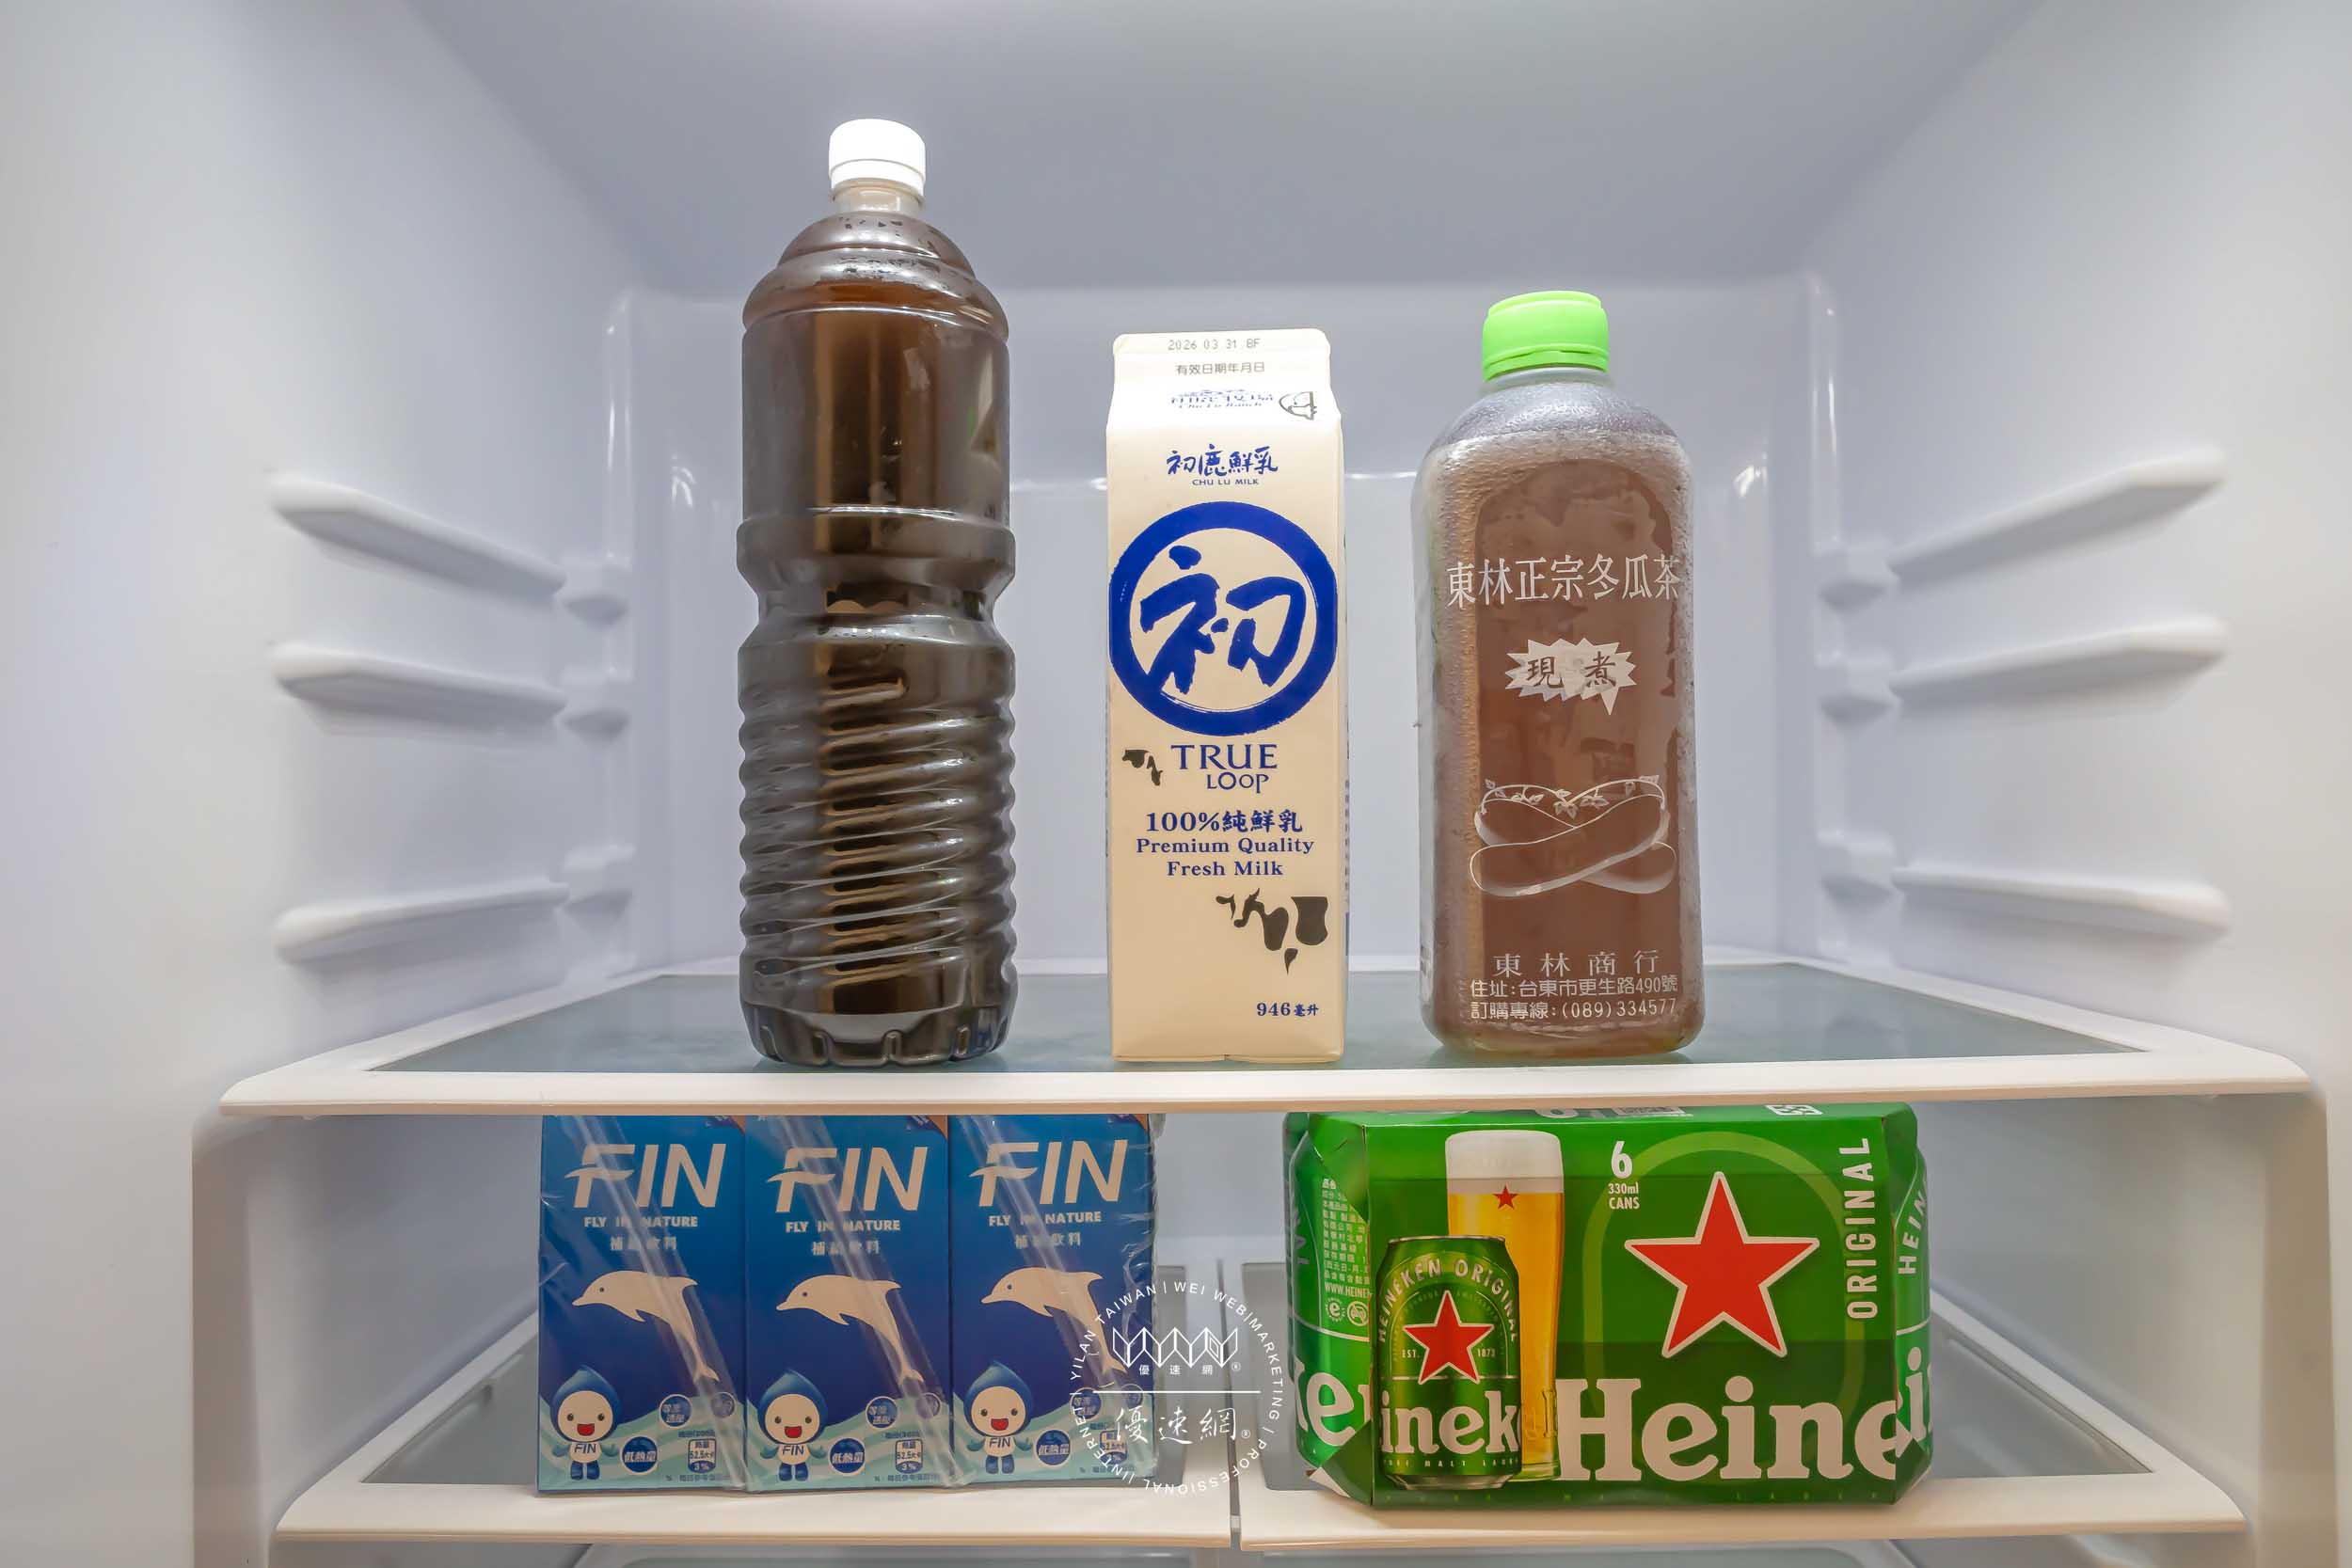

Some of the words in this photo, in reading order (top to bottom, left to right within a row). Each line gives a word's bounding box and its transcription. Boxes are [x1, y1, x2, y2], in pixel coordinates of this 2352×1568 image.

[1168, 340, 1197, 351] 2026
[1203, 339, 1218, 350] 03
[1226, 339, 1237, 349] 31
[1174, 361, 1265, 375] 有效日期年月日
[1166, 443, 1279, 476] 初鹿鮮乳
[1445, 553, 1682, 609] 東林正宗冬瓜茶
[1140, 545, 1307, 695] 初
[1526, 651, 1616, 689] 現煮
[1170, 744, 1278, 770] TRUE
[1146, 809, 1303, 833] 100%純鮮乳
[1136, 838, 1229, 853] Premium
[1237, 837, 1314, 854] Quality
[1167, 861, 1225, 876] Fresh
[1234, 861, 1283, 876] Milk
[1492, 950, 1661, 977] 東林商行
[1256, 1003, 1319, 1017] 946毫升
[1610, 1140, 1634, 1179] 6
[564, 1143, 726, 1209] FIN
[767, 1147, 928, 1212] FIN
[969, 1139, 1128, 1207] FIN
[1608, 1182, 1639, 1195] 330ml
[1608, 1196, 1640, 1210] CANS
[583, 1216, 607, 1227] FLY
[642, 1215, 698, 1227] NATURE
[786, 1221, 809, 1233] FLY
[842, 1219, 900, 1232] NATURE
[989, 1214, 1010, 1227] FLY
[1044, 1212, 1101, 1224] NATURE
[1838, 1137, 1878, 1319] ORIGINAL
[1377, 1258, 1441, 1343] HEINEKEN
[1454, 1259, 1518, 1342] ORIGINAL
[1477, 1348, 1496, 1358] 1873
[1381, 1390, 1521, 1455] inek
[574, 1443, 596, 1454] FIN
[782, 1444, 804, 1456] FIN
[989, 1437, 1011, 1449] FIN
